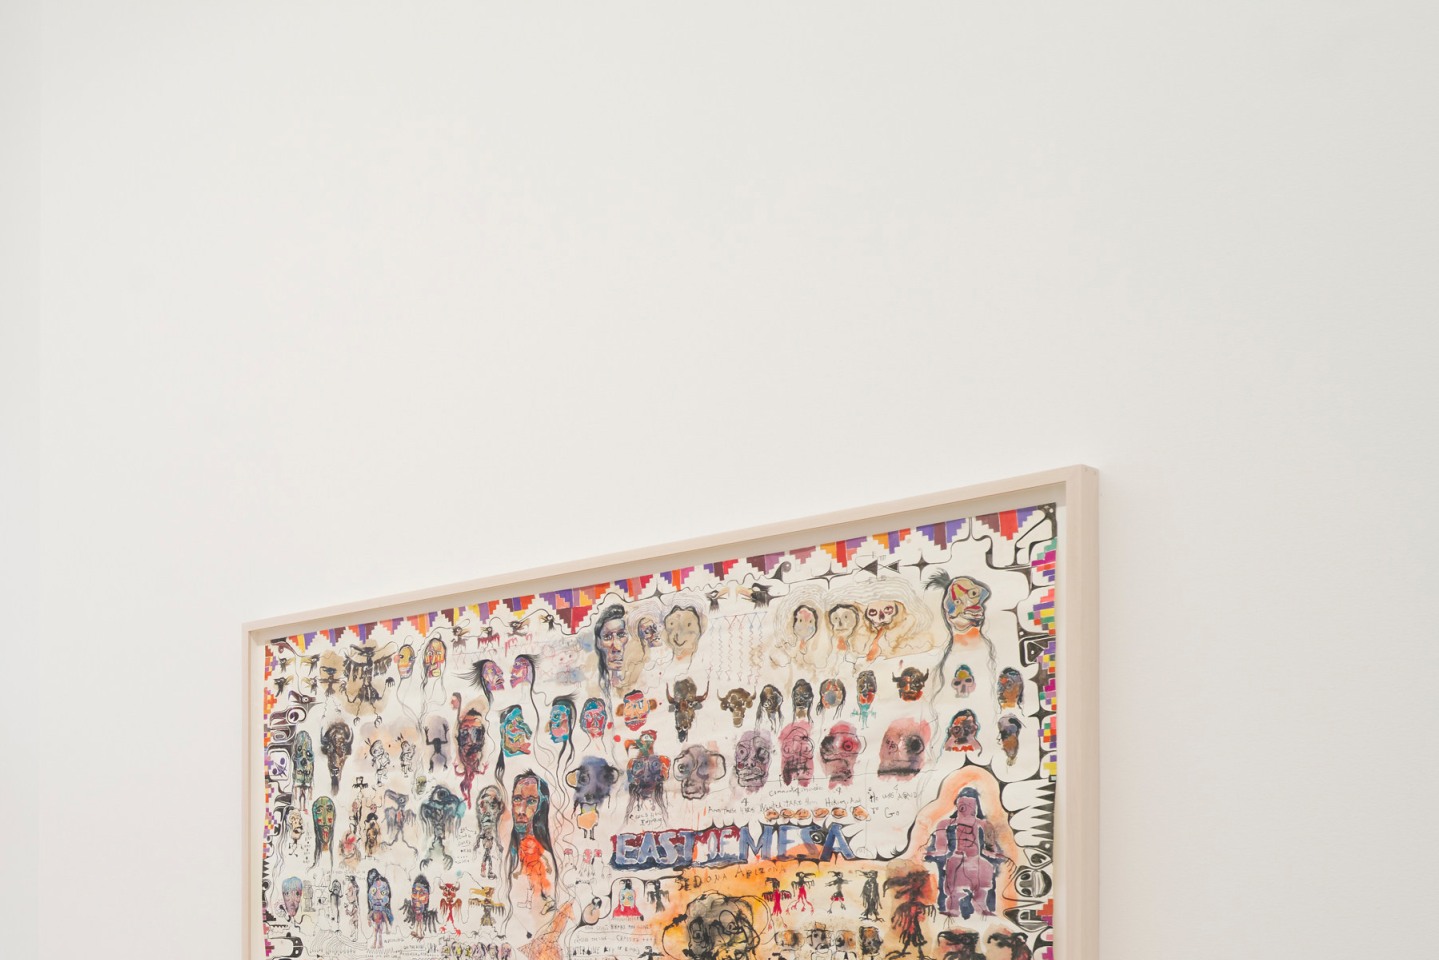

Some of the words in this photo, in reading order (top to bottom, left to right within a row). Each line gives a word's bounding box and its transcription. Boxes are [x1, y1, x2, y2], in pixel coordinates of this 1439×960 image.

[614, 830, 695, 866] EAST
[706, 828, 735, 861] OF
[738, 821, 858, 862] MESA
